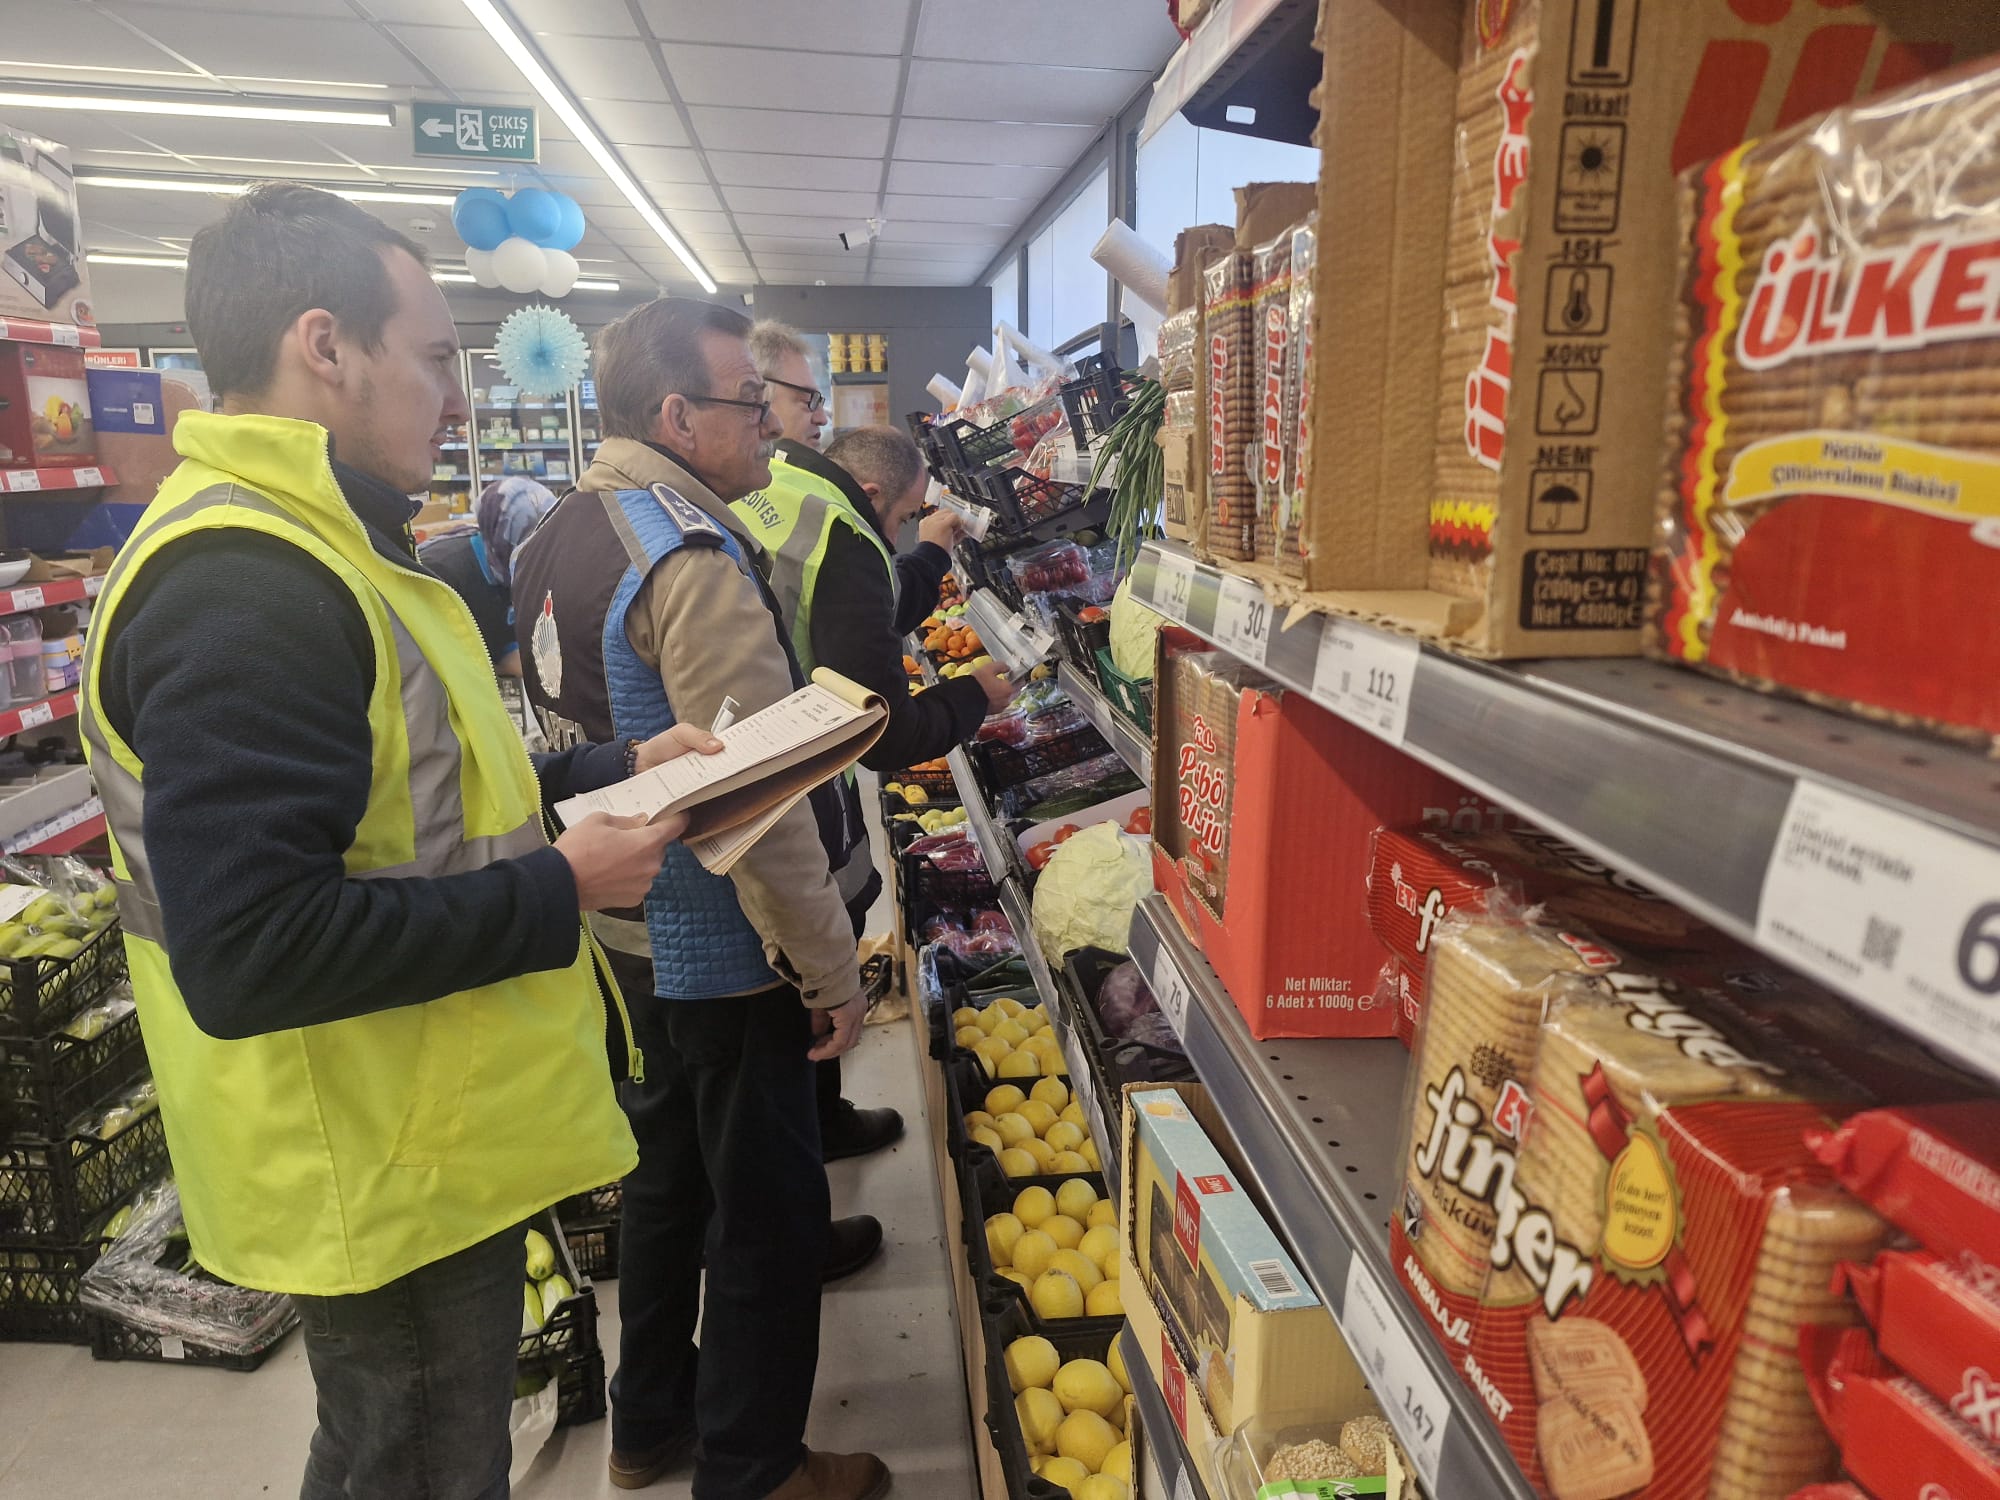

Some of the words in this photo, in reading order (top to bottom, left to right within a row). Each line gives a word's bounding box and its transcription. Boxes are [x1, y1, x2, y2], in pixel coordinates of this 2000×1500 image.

[488, 115, 529, 133] ÇIKIŞ
[492, 133, 526, 149] EXIT
[1743, 234, 2000, 358] ÜLKE
[1211, 334, 1228, 476] ÜLKER
[1264, 303, 1287, 485] ÜLKER
[1538, 446, 1593, 466] NEM
[1171, 571, 1187, 605] 32
[1244, 600, 1265, 640] 30
[1367, 667, 1395, 702] 112
[1169, 980, 1183, 1016] 79
[1285, 977, 1306, 991] Net
[1309, 976, 1352, 991] Miktar:
[1266, 995, 1274, 1008] 6
[1277, 994, 1305, 1008] Adet
[1307, 997, 1315, 1008] x
[1318, 994, 1354, 1011] 1000g
[1401, 1385, 1434, 1442] 147
